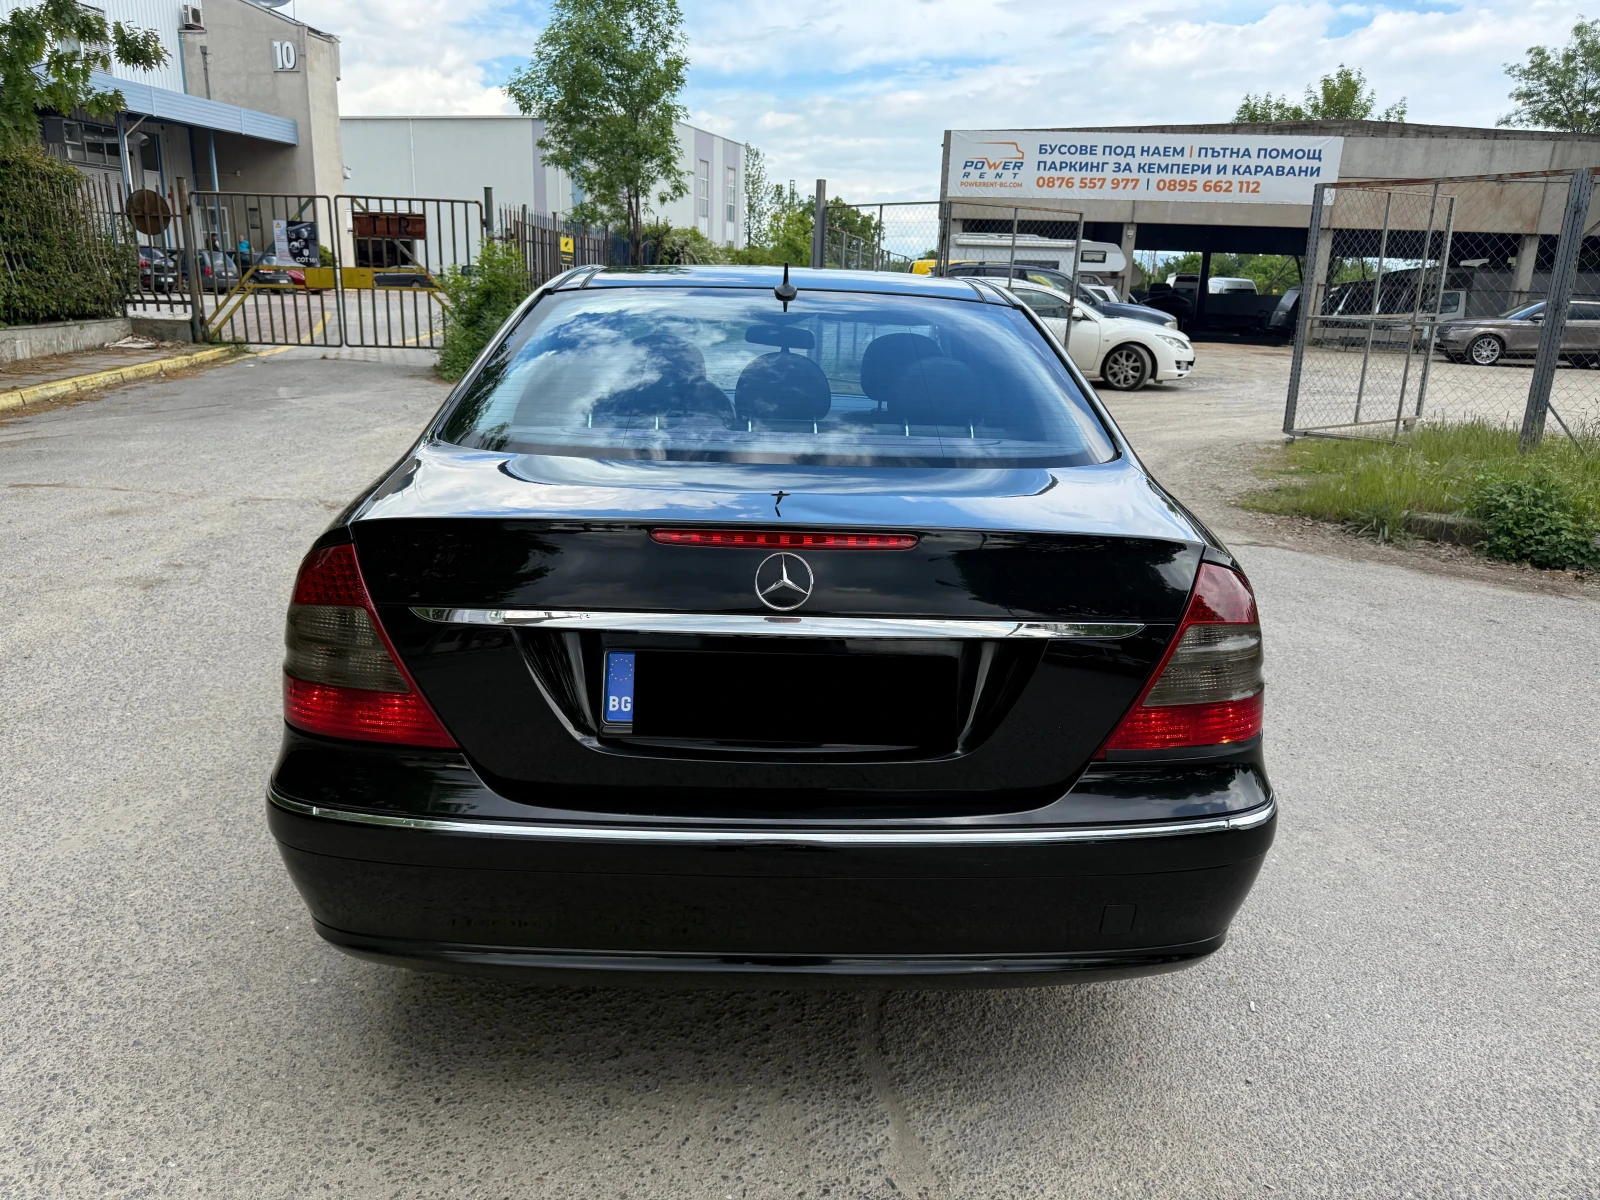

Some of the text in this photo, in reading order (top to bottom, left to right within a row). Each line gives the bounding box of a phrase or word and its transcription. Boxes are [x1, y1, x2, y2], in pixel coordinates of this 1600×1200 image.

[273, 41, 296, 69] 10
[1038, 144, 1323, 162] БУСОВЕ ПОД НАЕМ ПЪТНА ПОМОЩ
[962, 159, 1024, 171] POWER
[1036, 160, 1321, 178] ПАРКИНГ ЗА КЕМПЕРИ И КАРАВАНИ
[1036, 176, 1261, 194] 0876 557 977 0895 662 112
[368, 215, 410, 236] TIR
[609, 696, 632, 711] BG
